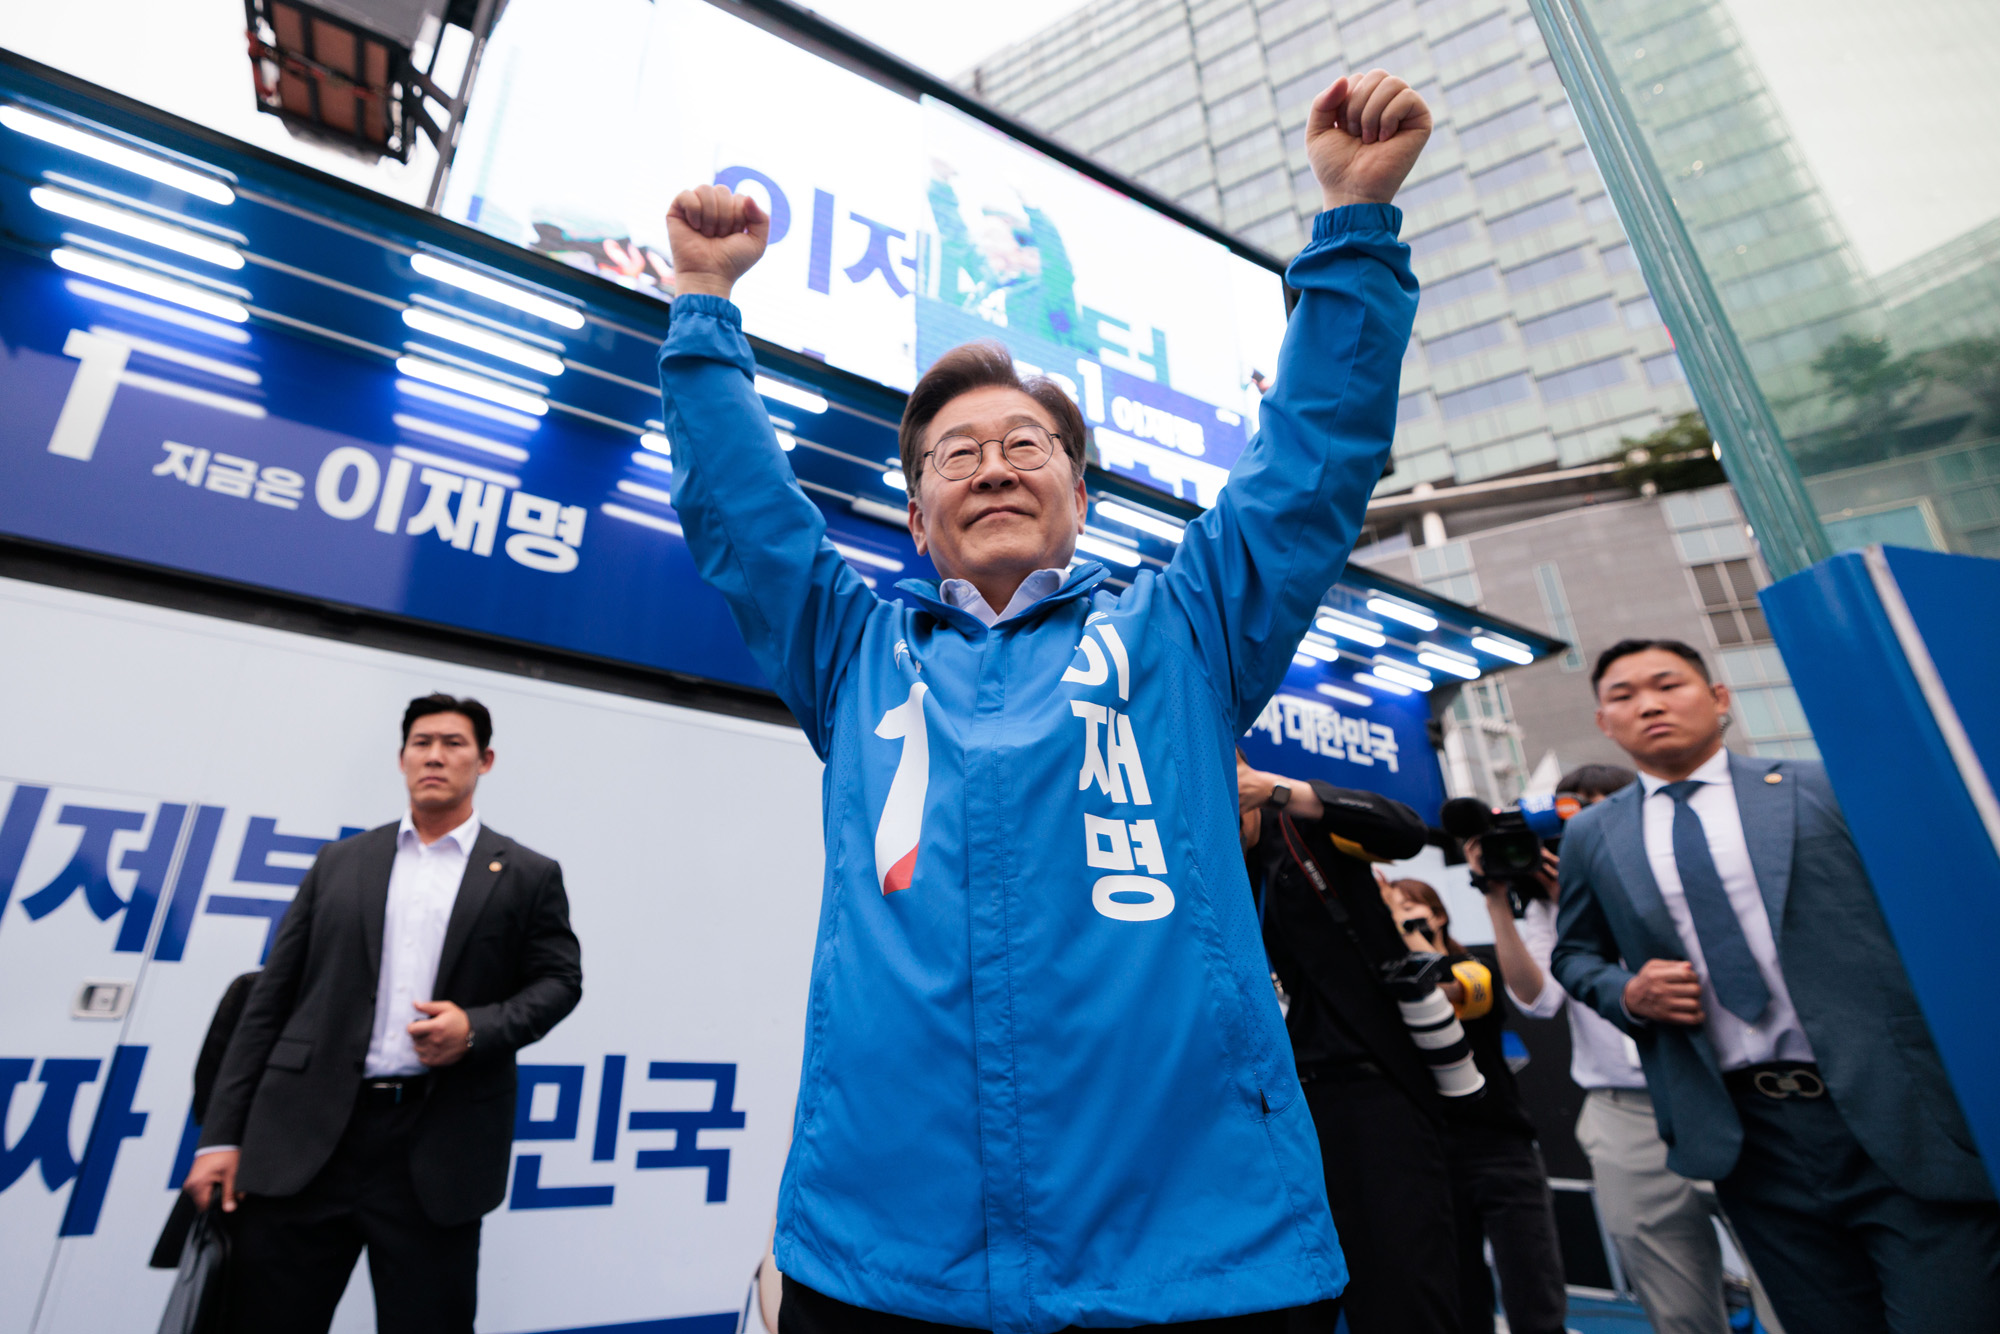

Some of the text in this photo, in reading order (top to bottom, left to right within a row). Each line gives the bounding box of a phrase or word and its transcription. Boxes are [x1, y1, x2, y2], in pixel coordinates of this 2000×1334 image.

[47, 328, 588, 574] 1 지금은 이재명
[873, 681, 930, 897] 1
[1060, 623, 1176, 922] 이재명
[1283, 703, 1400, 774] 대한민국
